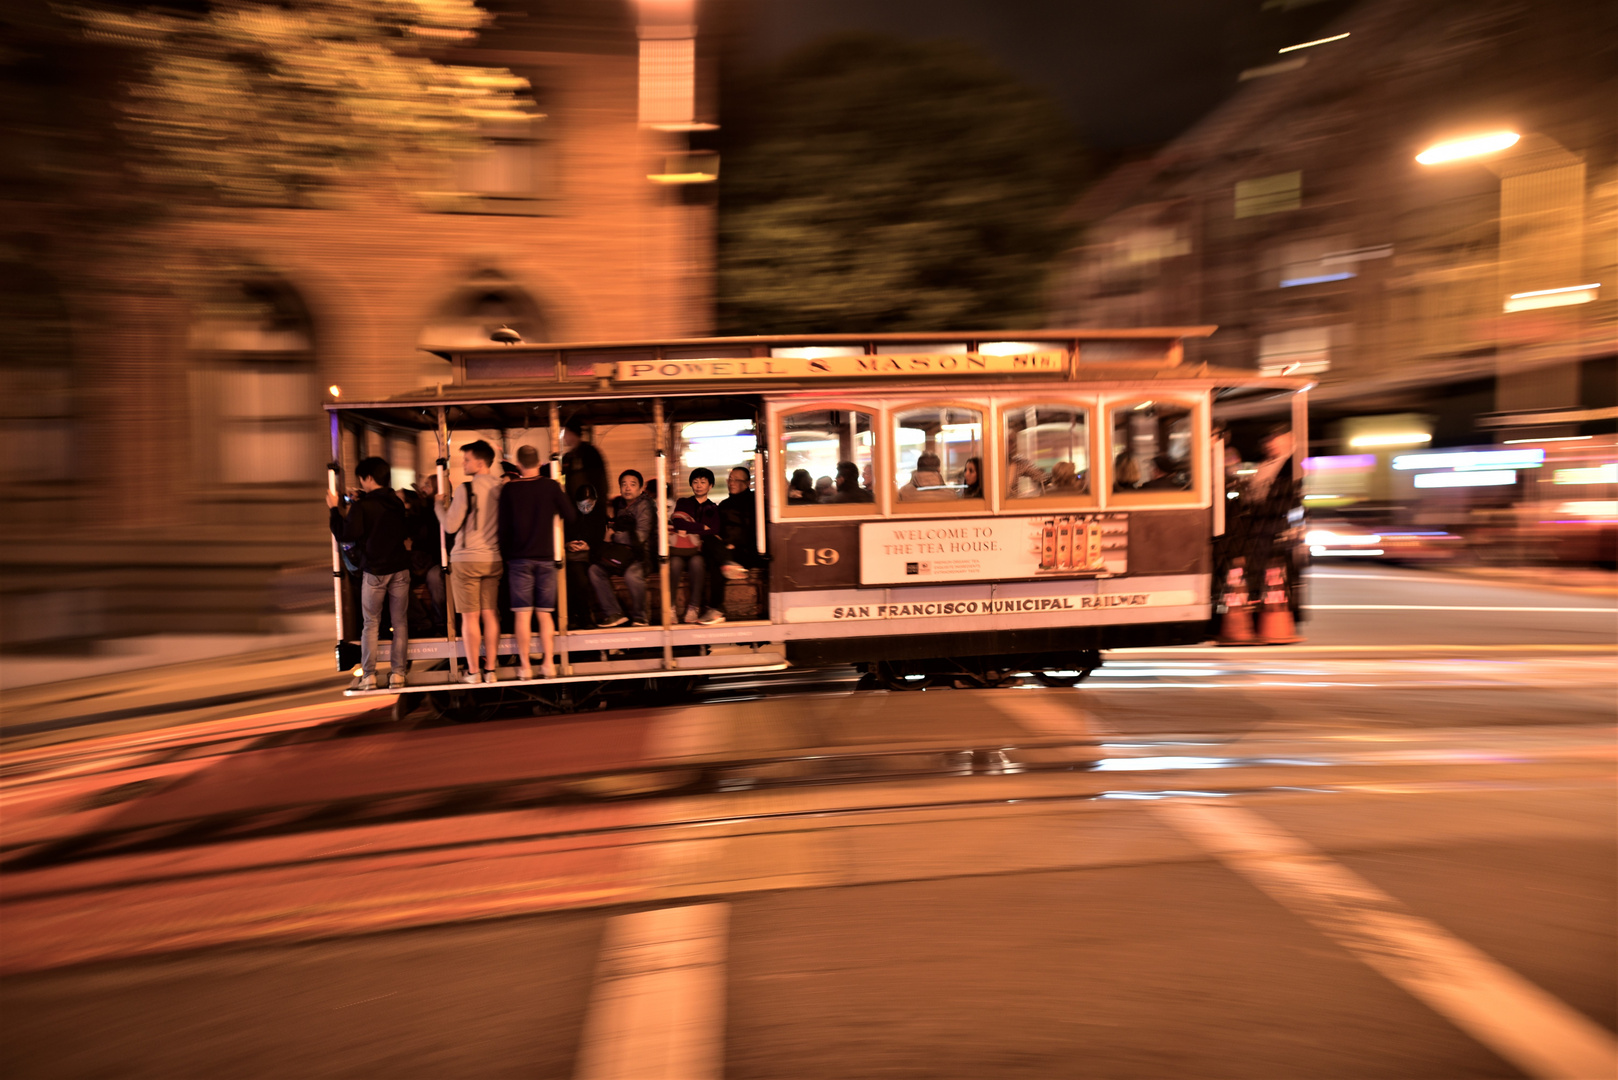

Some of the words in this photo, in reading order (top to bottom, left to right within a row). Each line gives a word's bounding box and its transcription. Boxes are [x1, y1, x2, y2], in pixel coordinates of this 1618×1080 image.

[631, 361, 788, 377] POWELL
[806, 358, 832, 373] &
[856, 355, 987, 372] MASON
[893, 527, 969, 541] WELCOME
[973, 526, 993, 538] TO
[803, 548, 840, 567] 19
[883, 544, 913, 556] THE
[918, 543, 945, 555] TEA
[950, 540, 1003, 553] HOUSE.
[833, 606, 870, 619] SAN
[878, 601, 978, 617] FRANCISCO
[982, 598, 1074, 613] MUNICIPAL
[1081, 593, 1150, 609] RAILWAY
